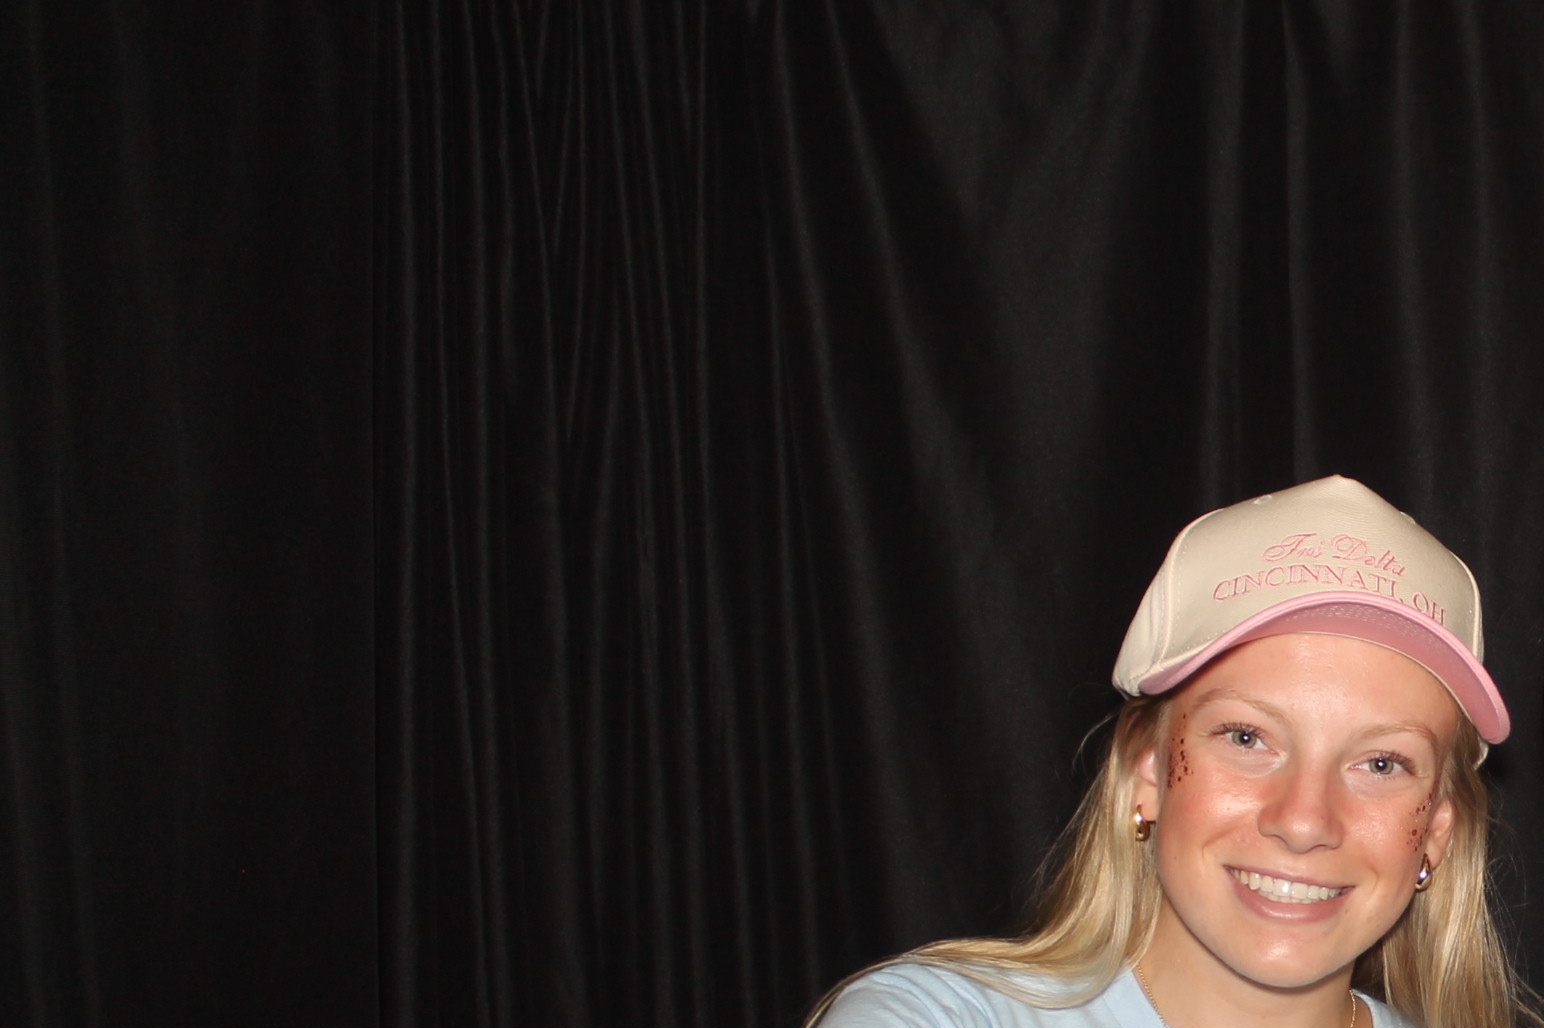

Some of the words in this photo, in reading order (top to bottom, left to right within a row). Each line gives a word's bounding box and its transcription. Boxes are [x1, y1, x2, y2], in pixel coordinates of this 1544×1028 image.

[1263, 532, 1325, 562] Tri
[1331, 533, 1407, 577] Delta
[1412, 591, 1447, 626] OH
